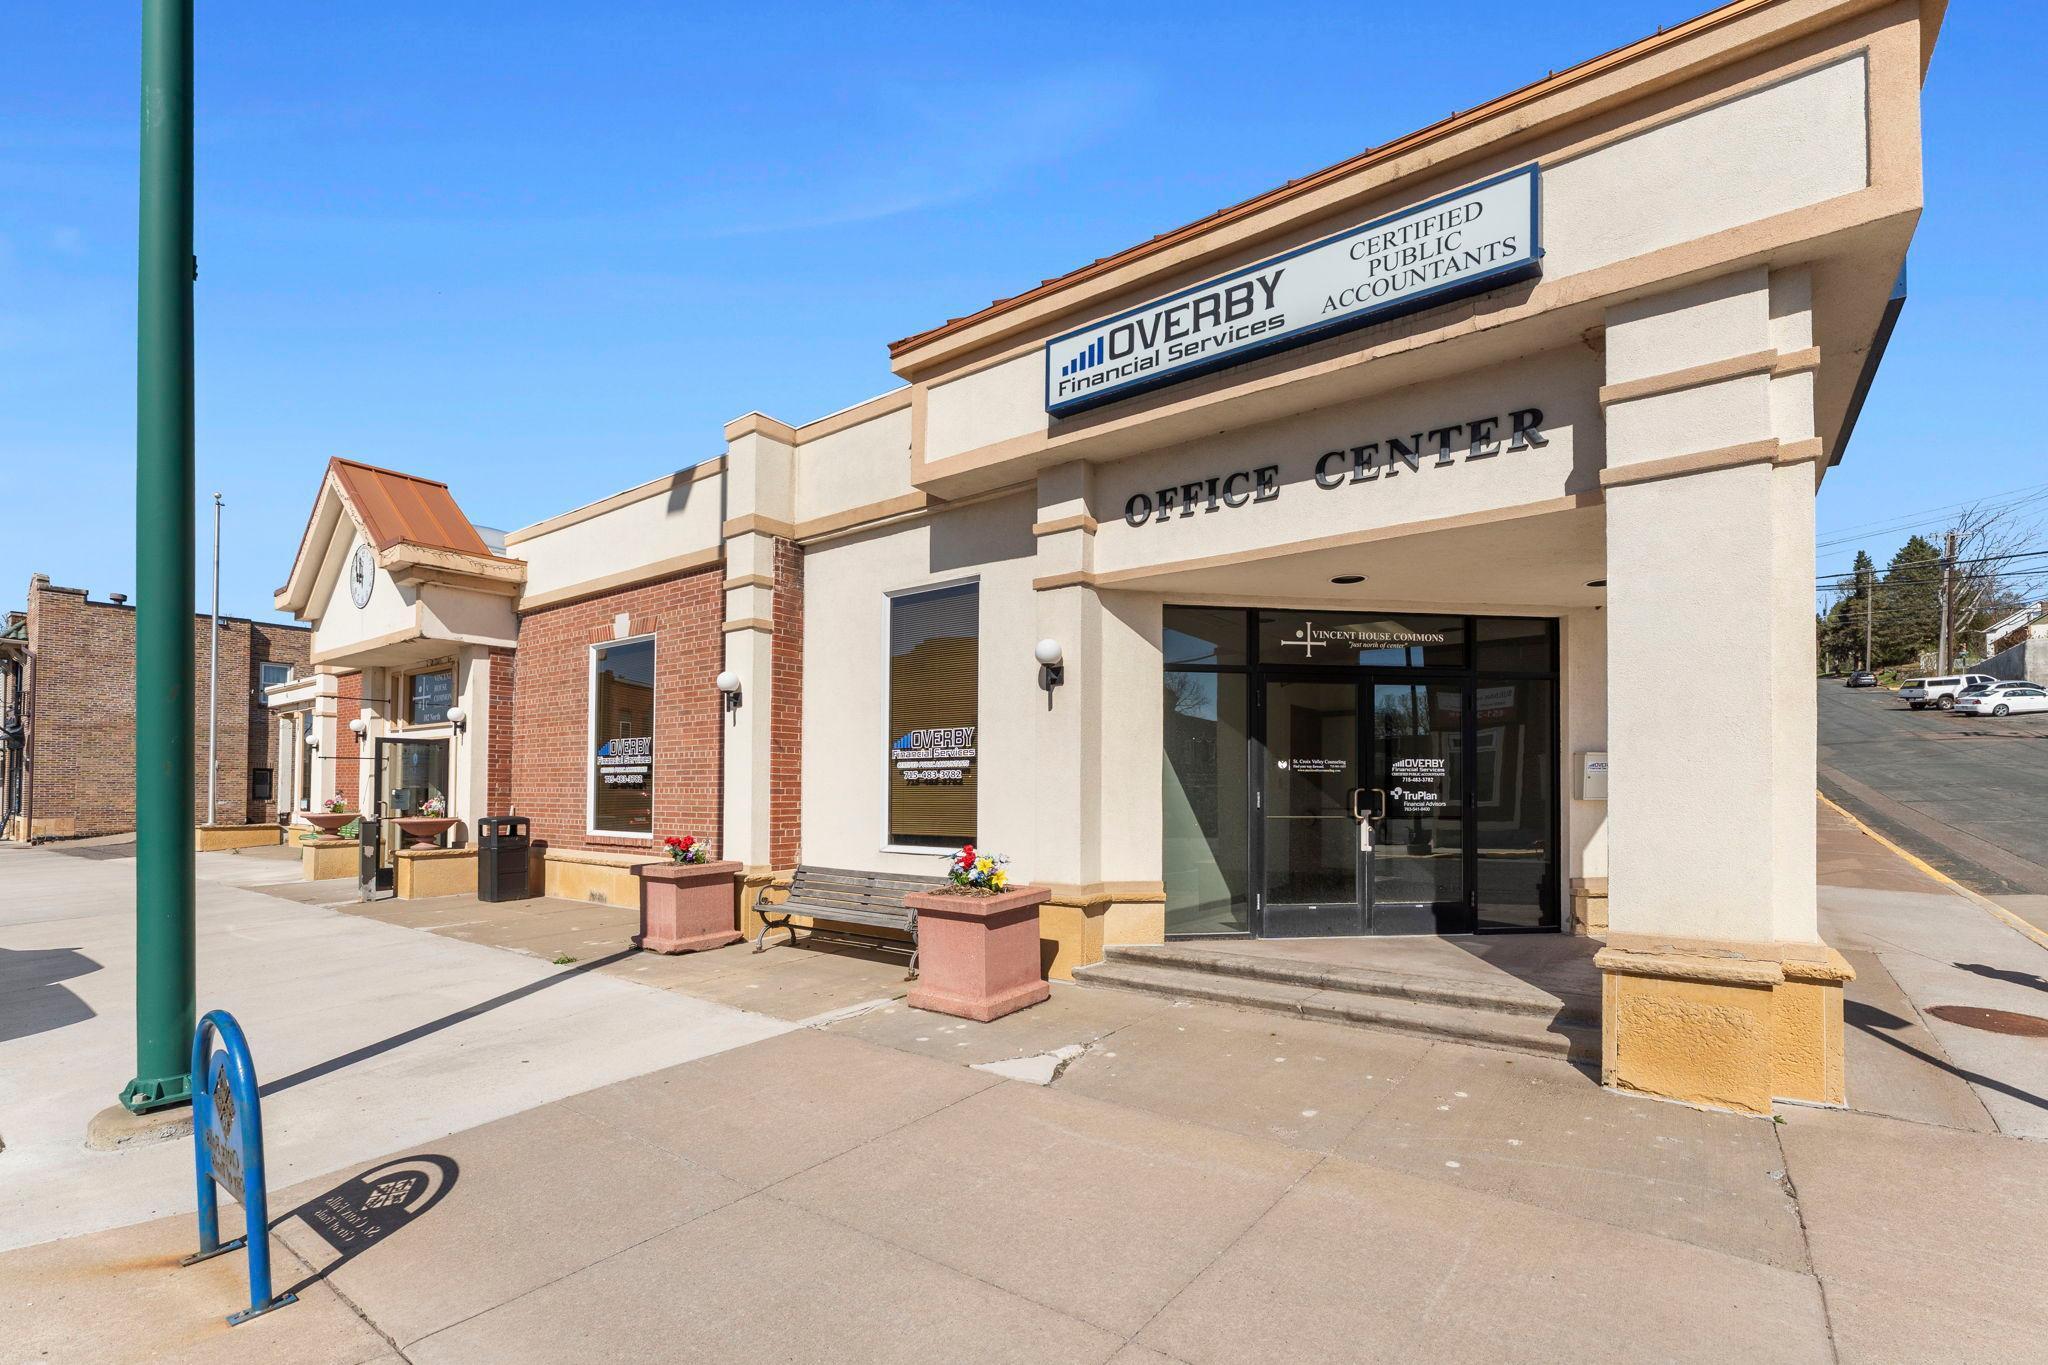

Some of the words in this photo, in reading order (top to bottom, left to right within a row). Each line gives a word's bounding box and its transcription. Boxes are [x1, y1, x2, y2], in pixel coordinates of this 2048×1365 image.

[1349, 201, 1483, 261] CERTIFIED
[1368, 230, 1463, 278] PUBLIC
[1321, 235, 1517, 315] ACCOUNTANTS
[1108, 269, 1286, 361] OVERBY
[1058, 353, 1160, 396] Financial
[1168, 313, 1286, 362] Services
[1124, 465, 1280, 528] OFFICE
[1315, 408, 1550, 490] CENTER
[1312, 630, 1356, 640] VINCENT
[1358, 632, 1391, 641] HOUSE
[1393, 632, 1444, 643] COMMONS
[610, 737, 652, 756] OVERBY
[911, 727, 975, 748] OVERBY
[892, 748, 932, 759] Financial
[934, 747, 976, 758] Services
[1404, 759, 1445, 768] OVERBY
[904, 770, 962, 779] 715-483-3782
[1402, 790, 1438, 801] TruPlan
